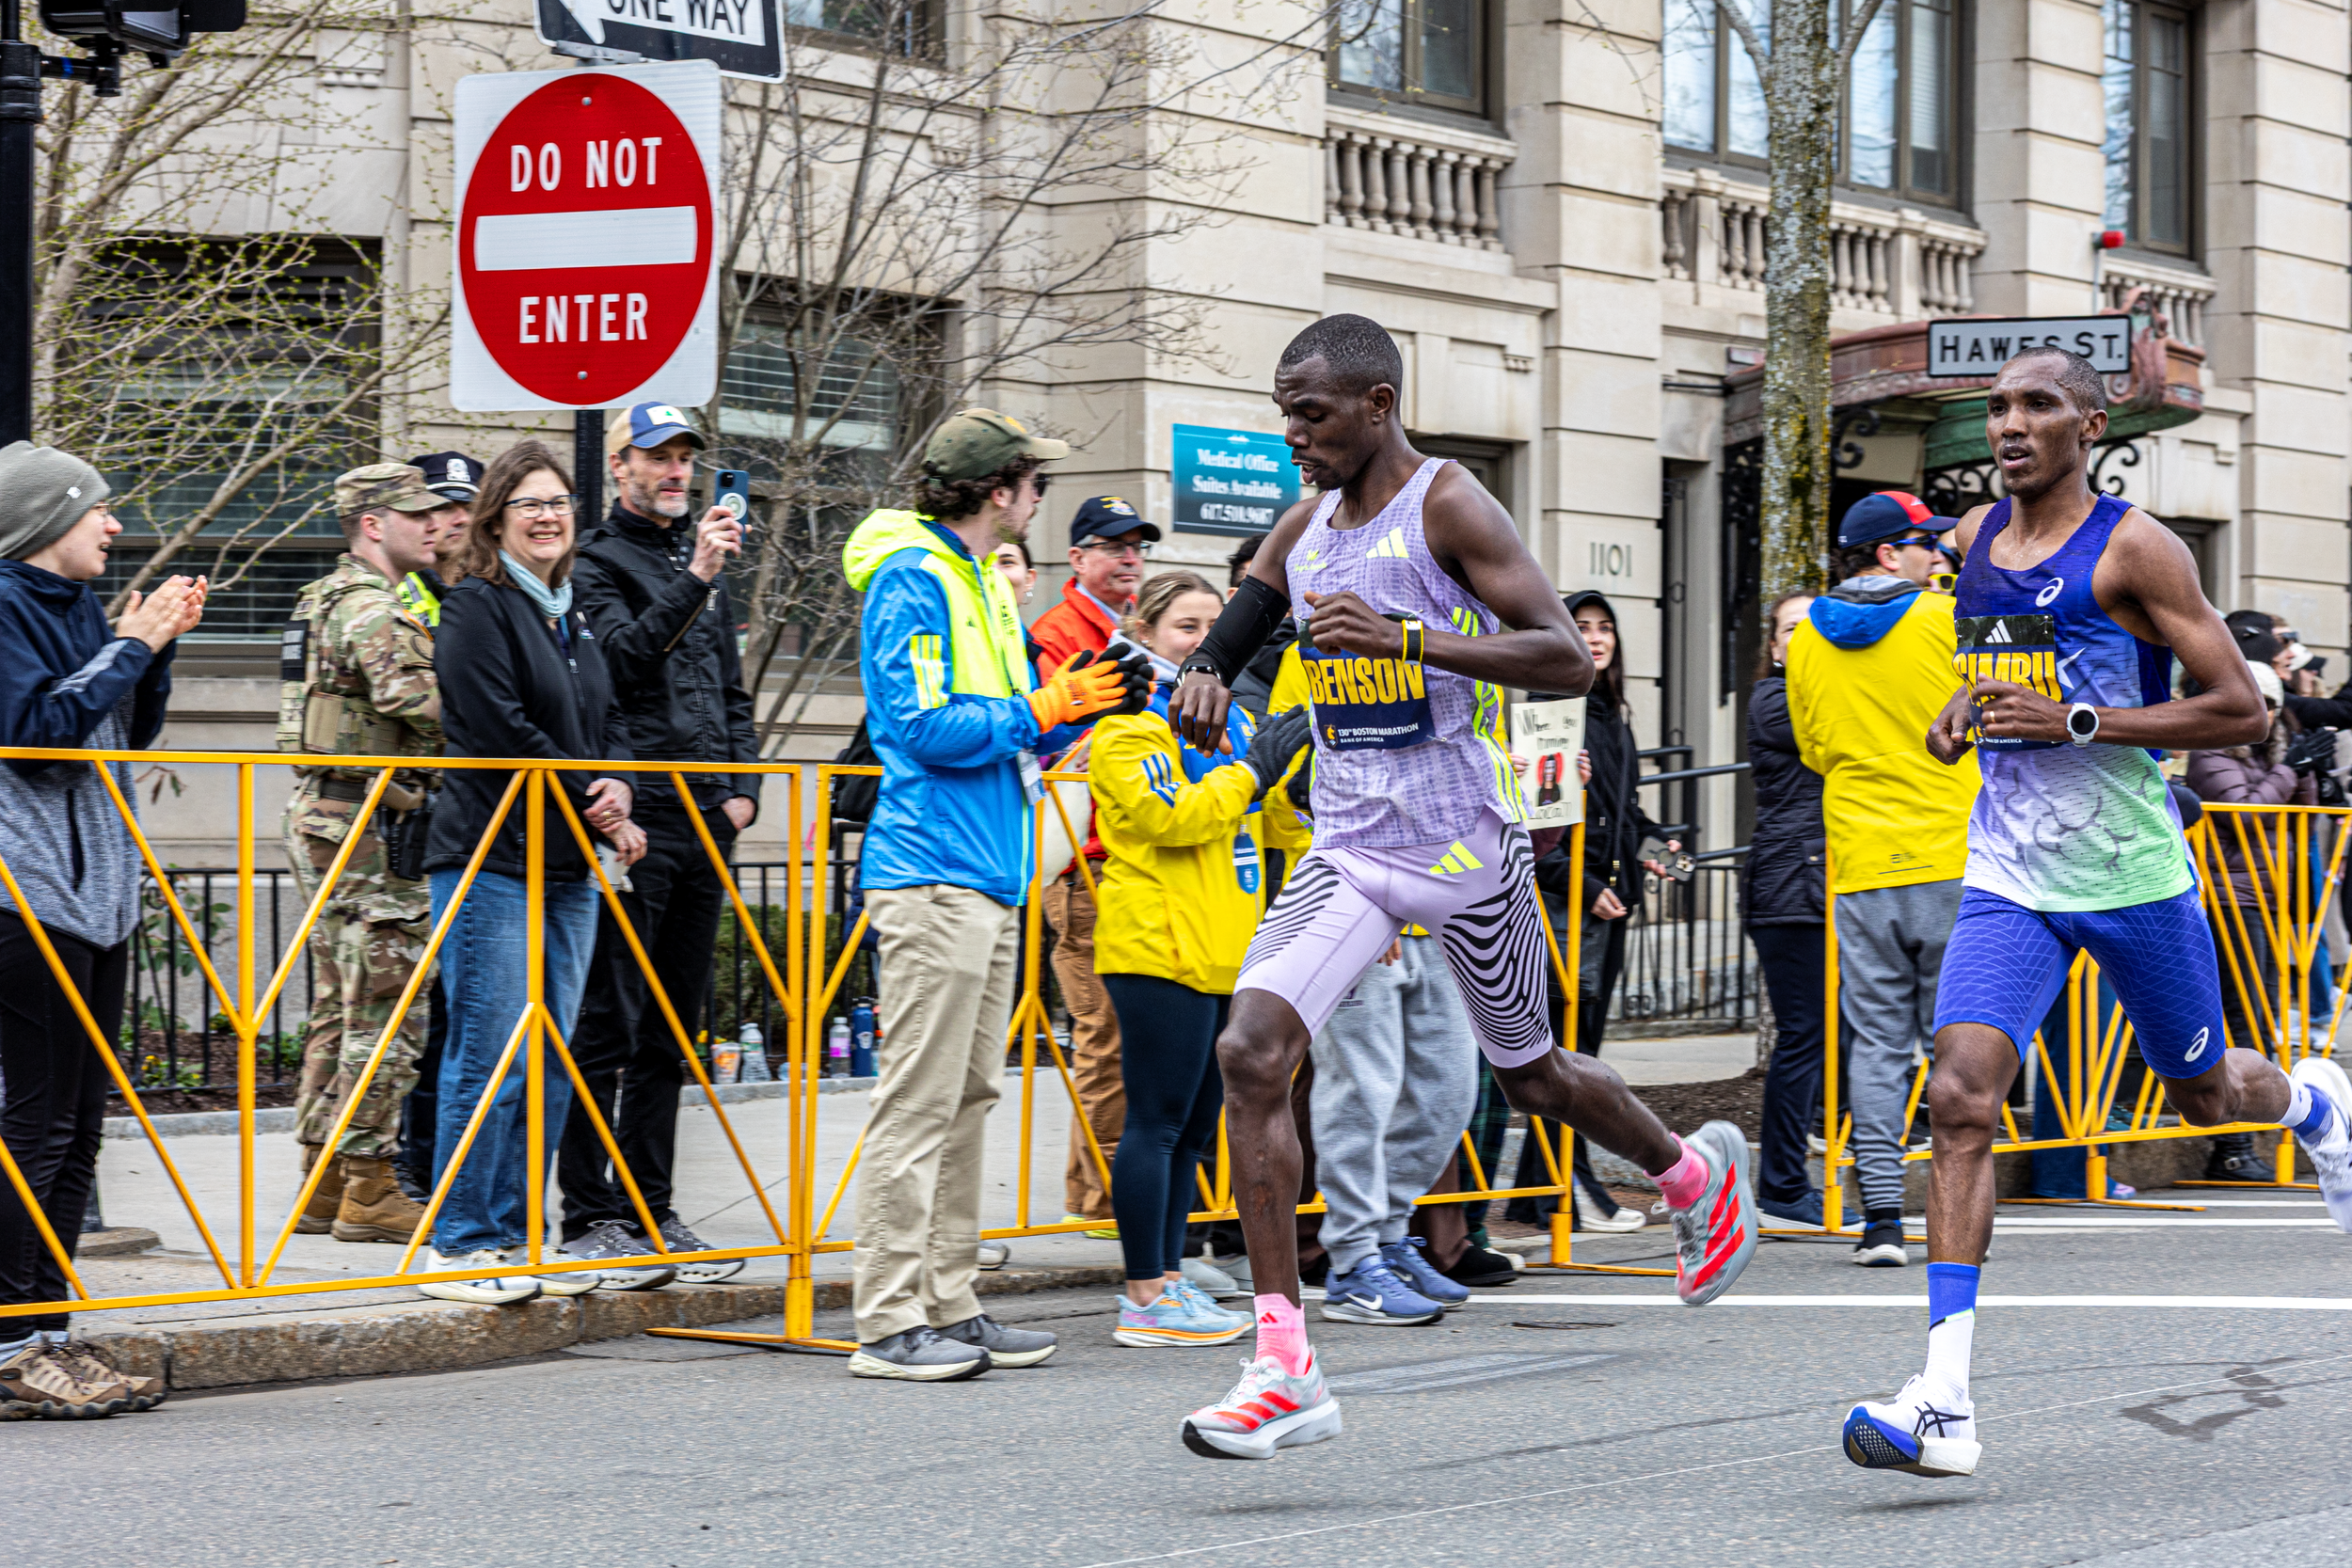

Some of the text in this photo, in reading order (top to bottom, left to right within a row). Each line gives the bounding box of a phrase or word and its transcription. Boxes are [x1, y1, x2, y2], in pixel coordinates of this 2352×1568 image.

[688, 0, 750, 36] WAY
[511, 137, 662, 192] DO NOT
[519, 293, 648, 344] ENTER
[2074, 331, 2124, 359] ST.
[1196, 449, 1280, 473] Medical Office
[1192, 475, 1283, 499] Suites Available
[1590, 542, 1632, 578] 1101
[1302, 657, 1425, 705] BENSON
[1352, 727, 1377, 736] BOSTON
[1378, 722, 1419, 736] MARATHON
